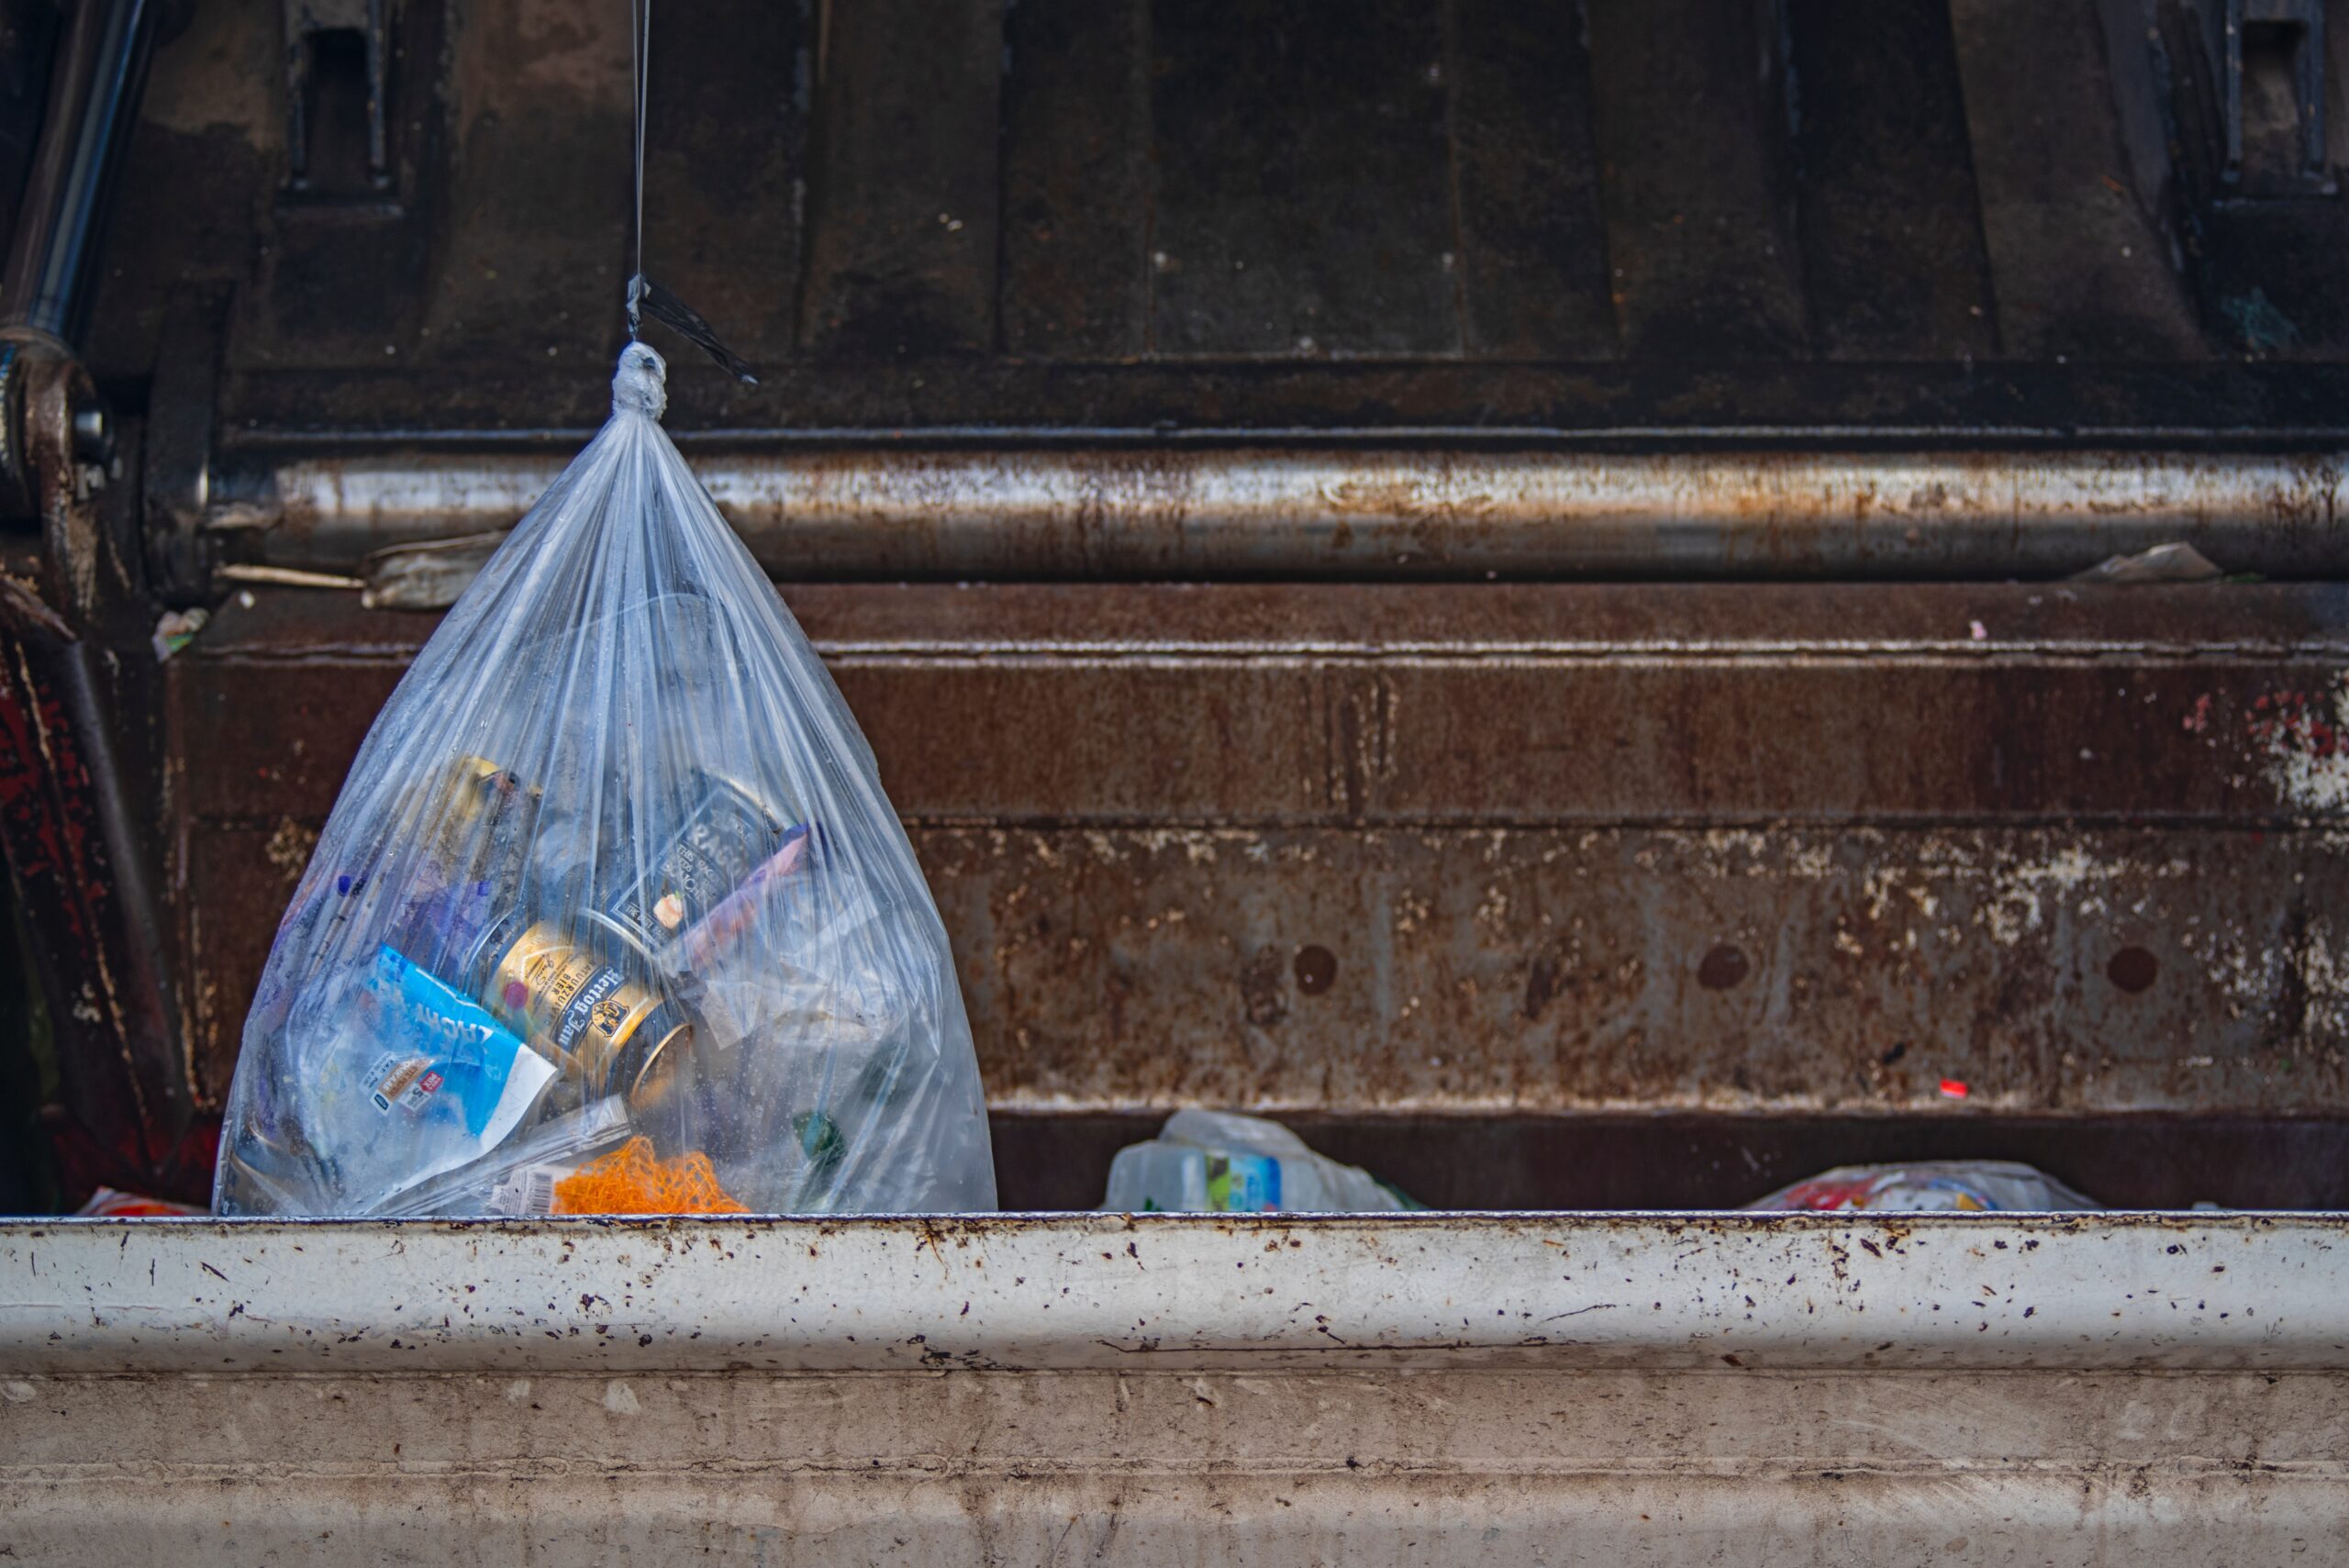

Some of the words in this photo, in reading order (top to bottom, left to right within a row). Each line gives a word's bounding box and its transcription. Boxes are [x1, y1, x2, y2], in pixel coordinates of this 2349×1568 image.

[676, 843, 696, 862] THIS
[551, 973, 572, 995] BIER
[574, 966, 624, 1016] Hertog
[558, 1010, 585, 1046] Jan
